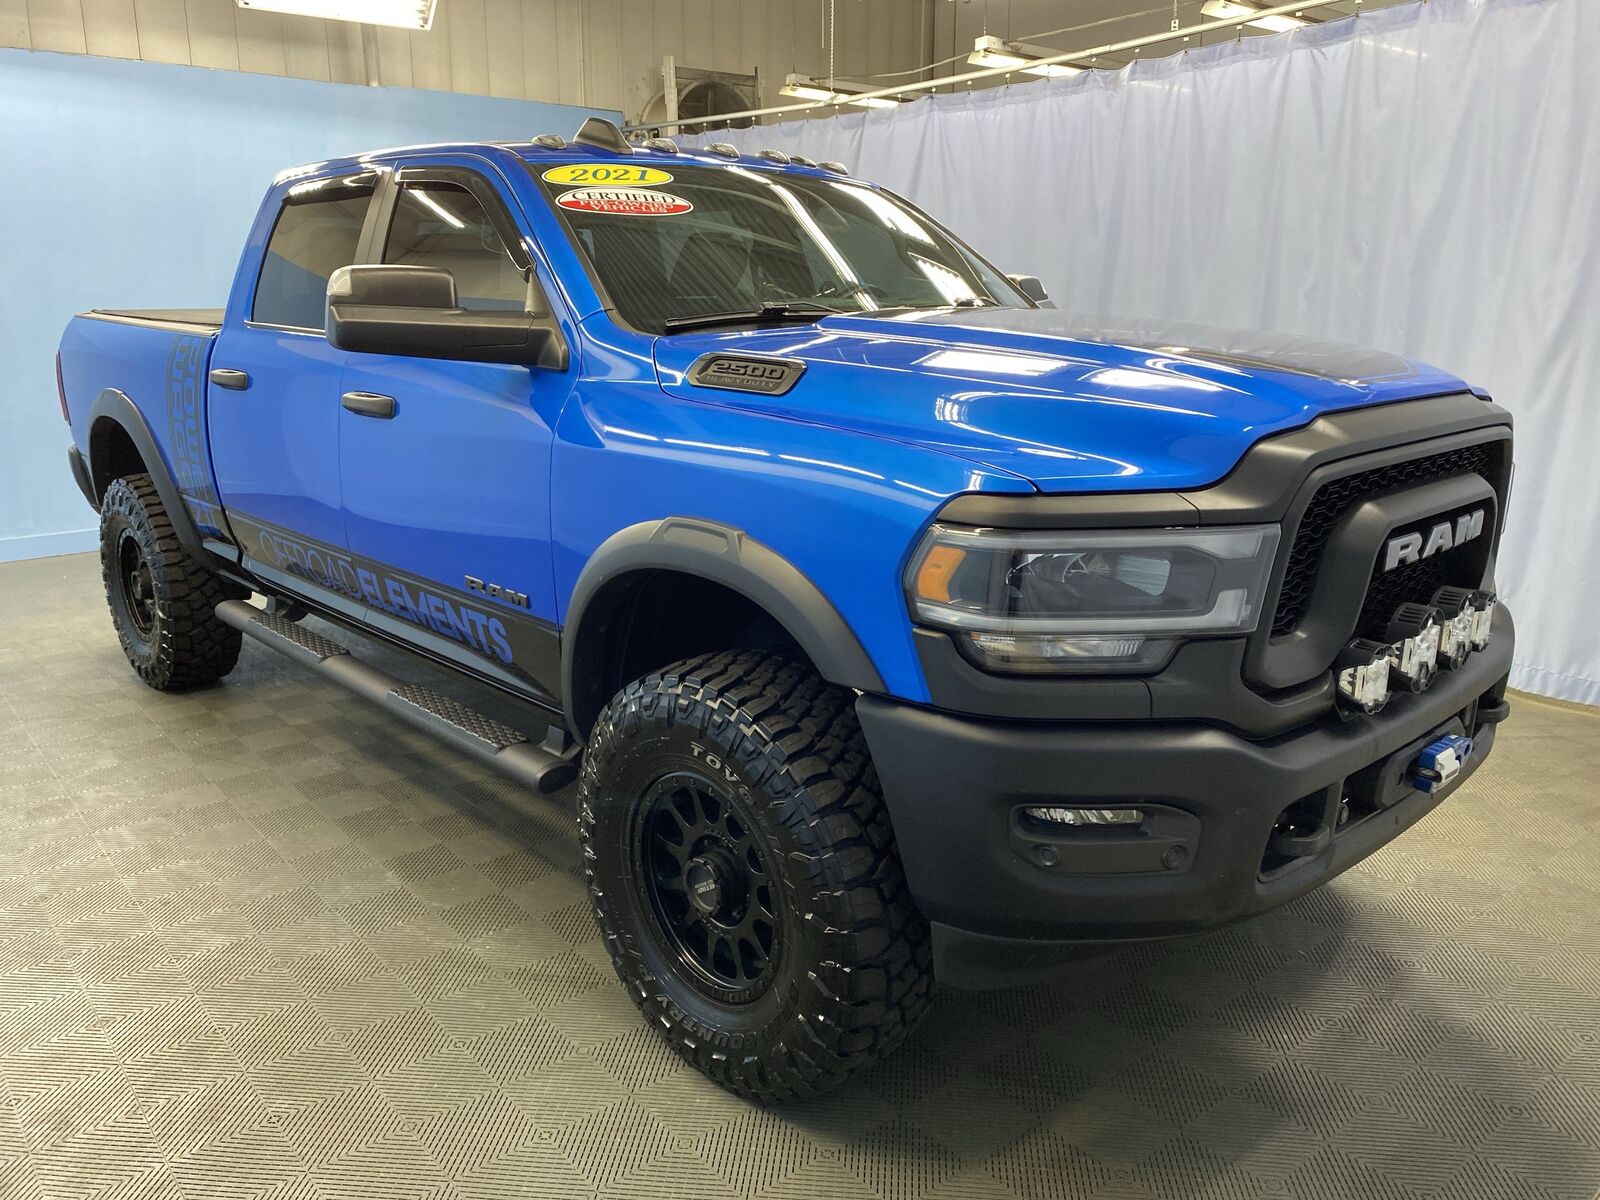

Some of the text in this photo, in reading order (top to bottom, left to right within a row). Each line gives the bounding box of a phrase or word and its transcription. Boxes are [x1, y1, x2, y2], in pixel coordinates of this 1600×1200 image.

[569, 168, 650, 182] 2021
[572, 191, 676, 204] CERTIFIED
[712, 362, 785, 380] 2500
[1384, 509, 1486, 572] RAM
[464, 575, 531, 609] RAM
[689, 740, 755, 806] TOYO
